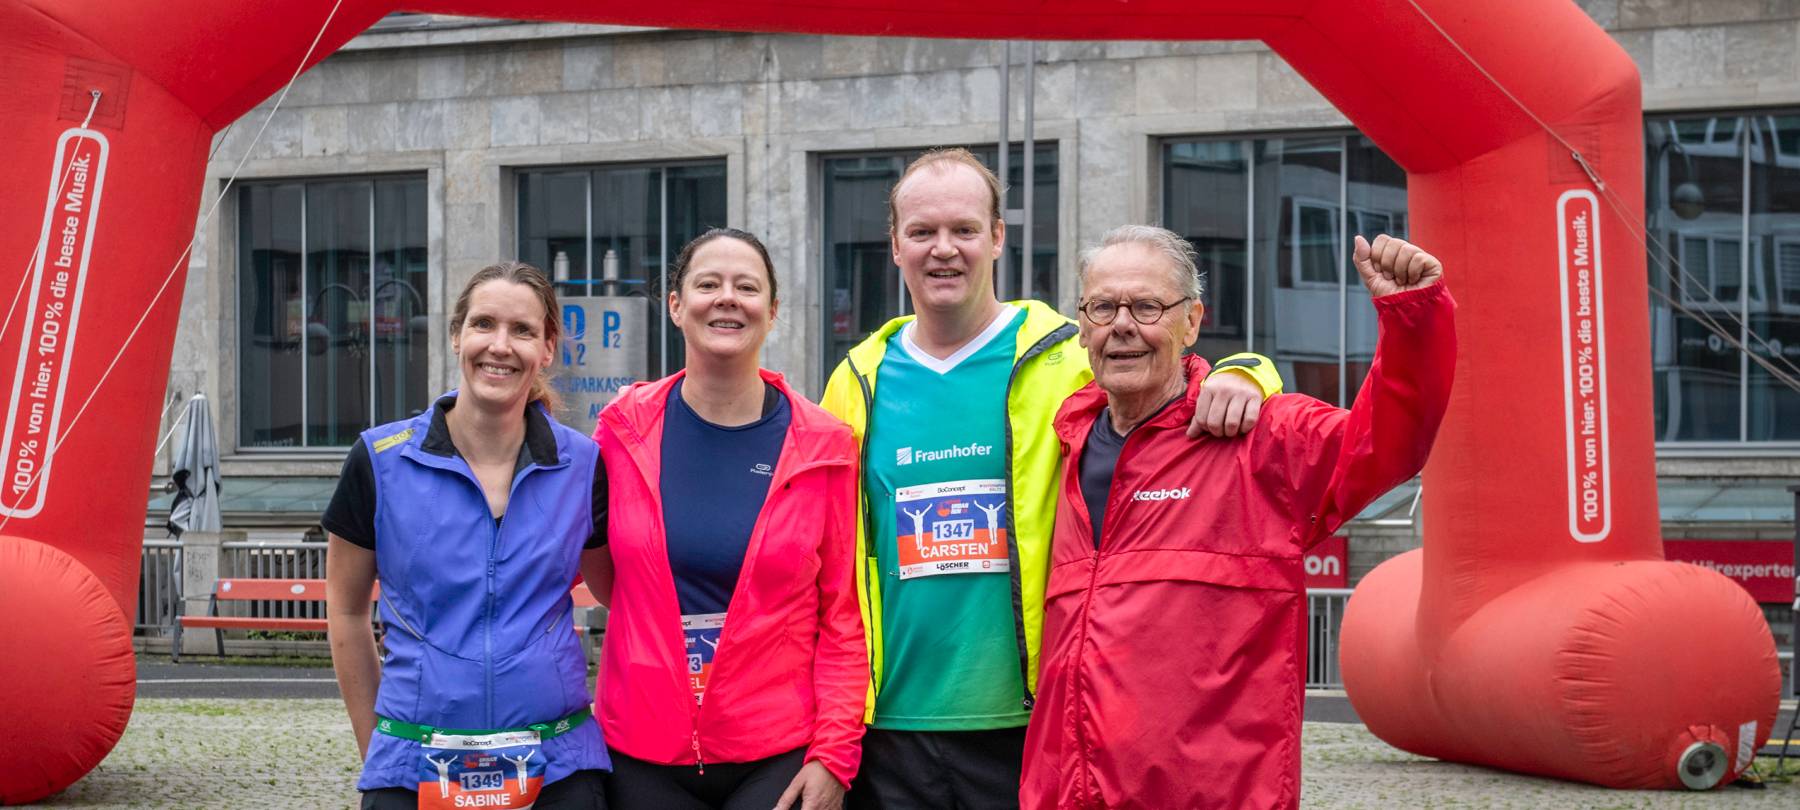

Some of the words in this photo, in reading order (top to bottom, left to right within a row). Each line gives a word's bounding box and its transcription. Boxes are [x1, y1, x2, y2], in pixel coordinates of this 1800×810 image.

[64, 152, 91, 213] Musik.
[54, 216, 79, 268] beste
[1572, 210, 1589, 266] Musik.
[50, 271, 69, 299] die
[1576, 269, 1591, 316] beste
[38, 303, 64, 357] 100%
[1577, 319, 1592, 343] die
[30, 362, 52, 398] hier.
[1578, 346, 1594, 397] 100%
[28, 402, 45, 434] von
[1581, 399, 1595, 435] hier.
[13, 439, 38, 494] 100%
[915, 443, 992, 463] Fraunhofer
[1585, 438, 1597, 467] von
[1583, 471, 1598, 522] 100%
[934, 522, 973, 539] 1347
[920, 542, 989, 559] CARSTEN
[462, 773, 502, 790] 1349
[454, 793, 511, 807] SABINE
